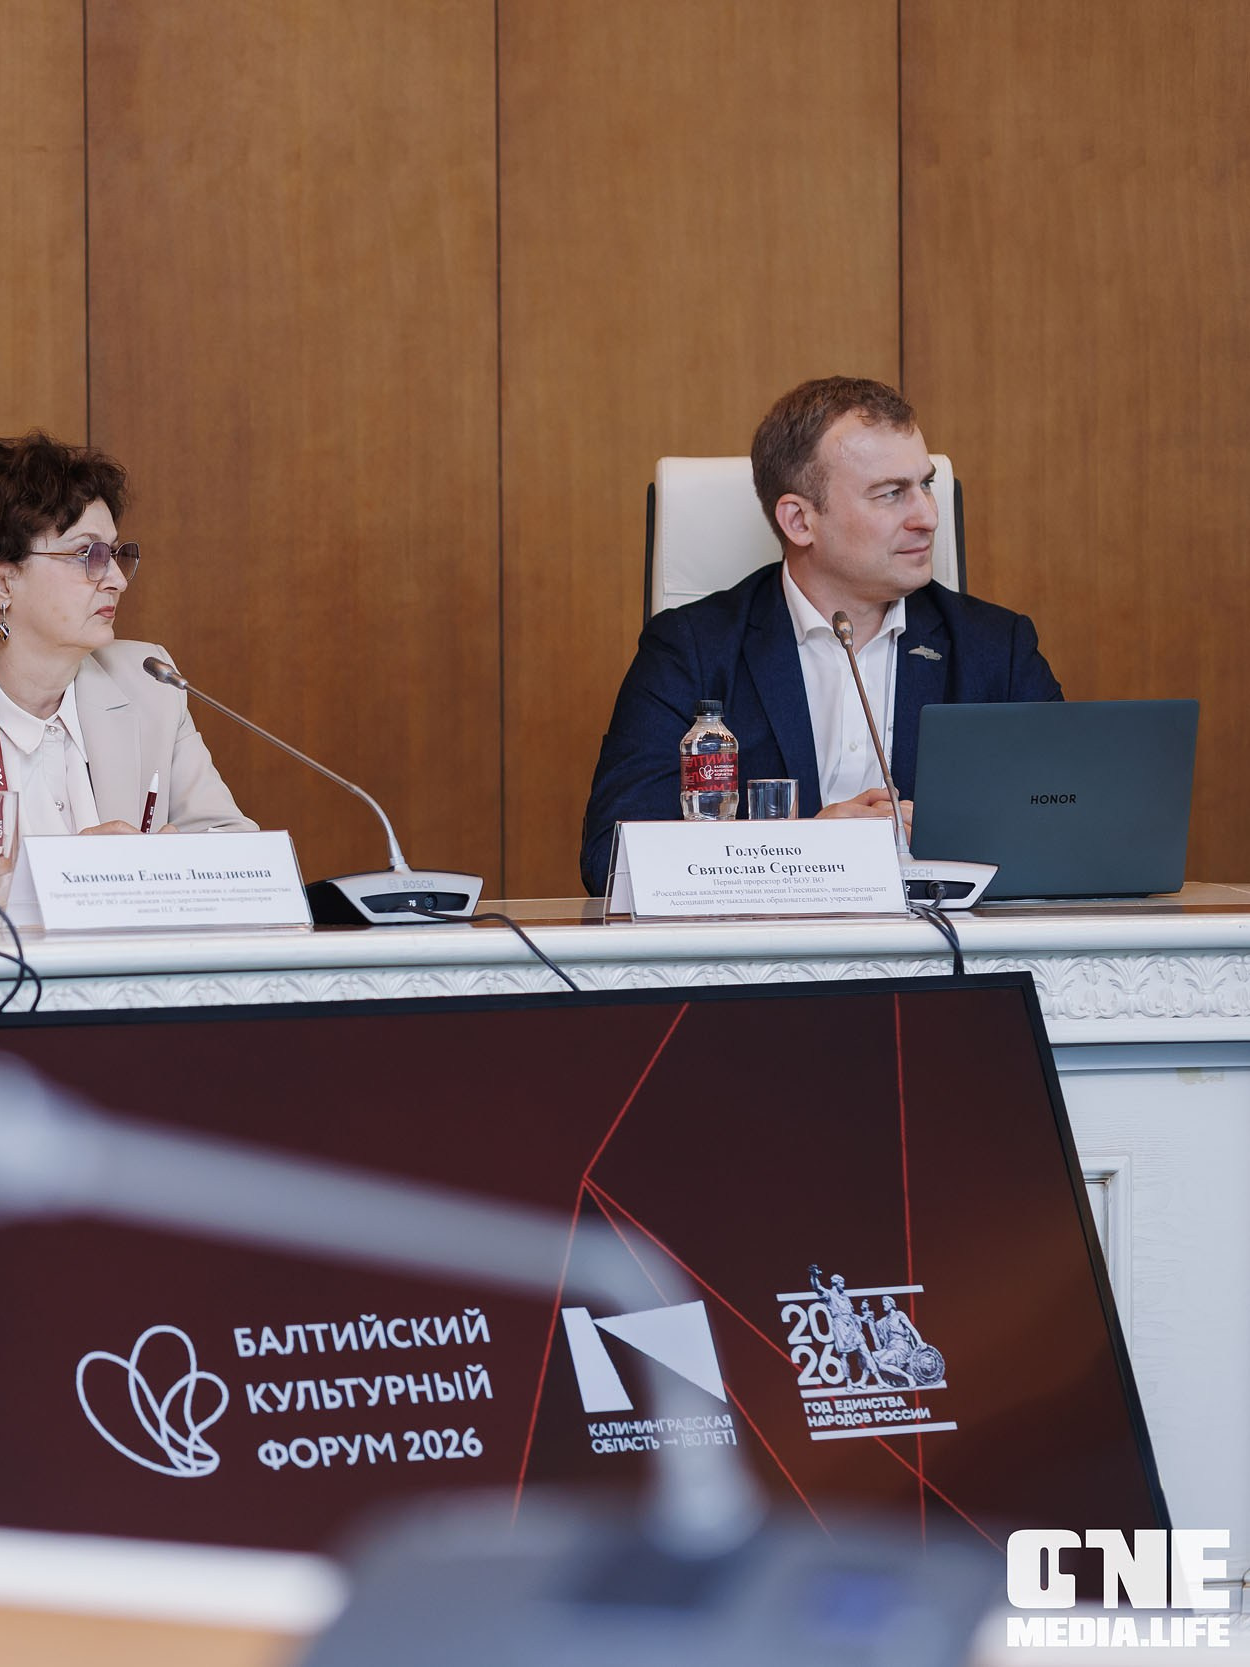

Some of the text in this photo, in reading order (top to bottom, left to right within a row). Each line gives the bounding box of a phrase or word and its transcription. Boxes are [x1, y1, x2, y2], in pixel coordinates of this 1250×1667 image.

[1030, 794, 1076, 805] HONOR
[725, 844, 802, 859] Голубенко
[61, 867, 272, 884] Хакимова Елена Ливадиевна
[687, 861, 845, 876] Святослав Сергеевич
[402, 879, 436, 890] BOSCH
[713, 876, 825, 888] Первый проректор ФГБОУ ВО
[233, 1307, 491, 1358] БАЛТИЙСКИЙ
[780, 1302, 835, 1345] 20
[790, 1344, 846, 1387] 26
[245, 1363, 494, 1414] КУЛЬТУРНЫЙ
[803, 1395, 907, 1415] ГОД ЕДИНСТВА
[587, 1414, 734, 1438] КАЛИНИНГРАДСКАЯ
[806, 1407, 932, 1428] НАРОДОВ РОССИИ
[257, 1426, 484, 1471] ФОРУМ 2026
[591, 1435, 660, 1454] ОБЛАСТЬ
